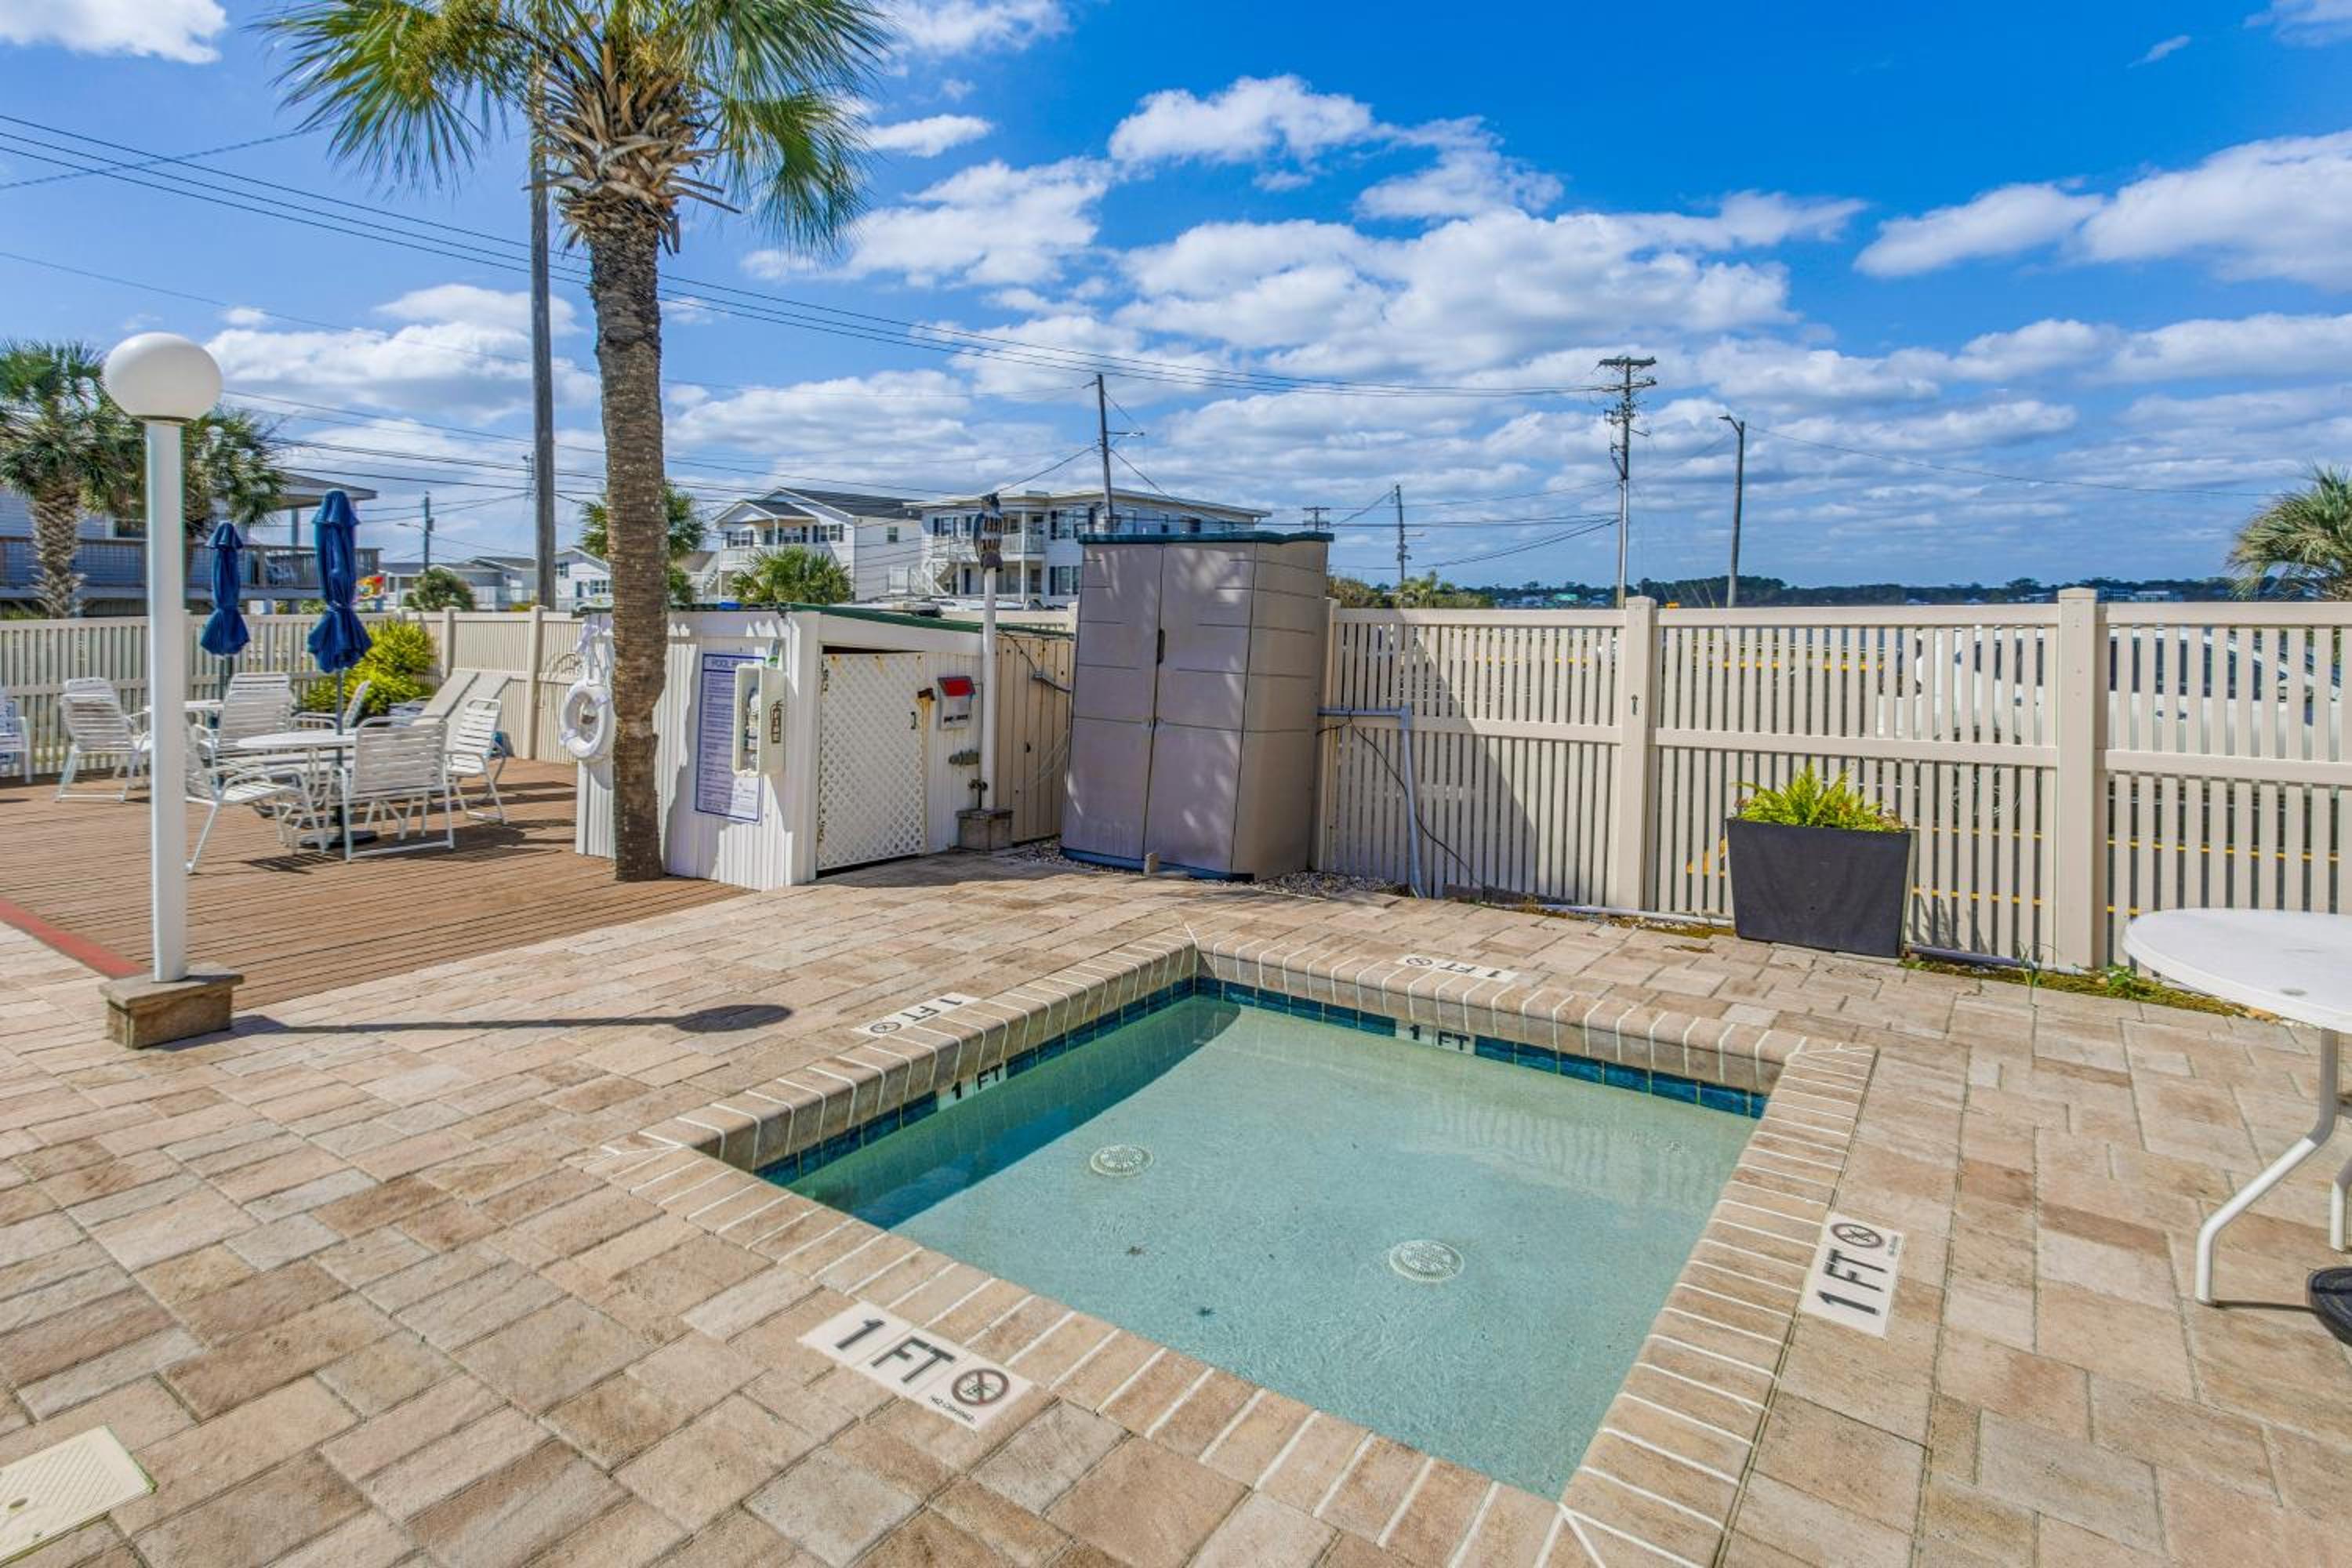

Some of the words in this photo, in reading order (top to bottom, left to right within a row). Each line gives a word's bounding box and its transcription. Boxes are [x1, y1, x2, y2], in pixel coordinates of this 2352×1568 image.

[1438, 962, 1477, 974] FT
[901, 1006, 940, 1022] FT
[1409, 1024, 1420, 1041] 1
[1438, 1030, 1470, 1051] FT
[953, 1081, 962, 1100] 1
[978, 1064, 1003, 1090] FT
[1823, 1248, 1888, 1292] FT
[1817, 1290, 1881, 1316] 1
[835, 1319, 885, 1350] 1
[871, 1336, 956, 1383] FT
